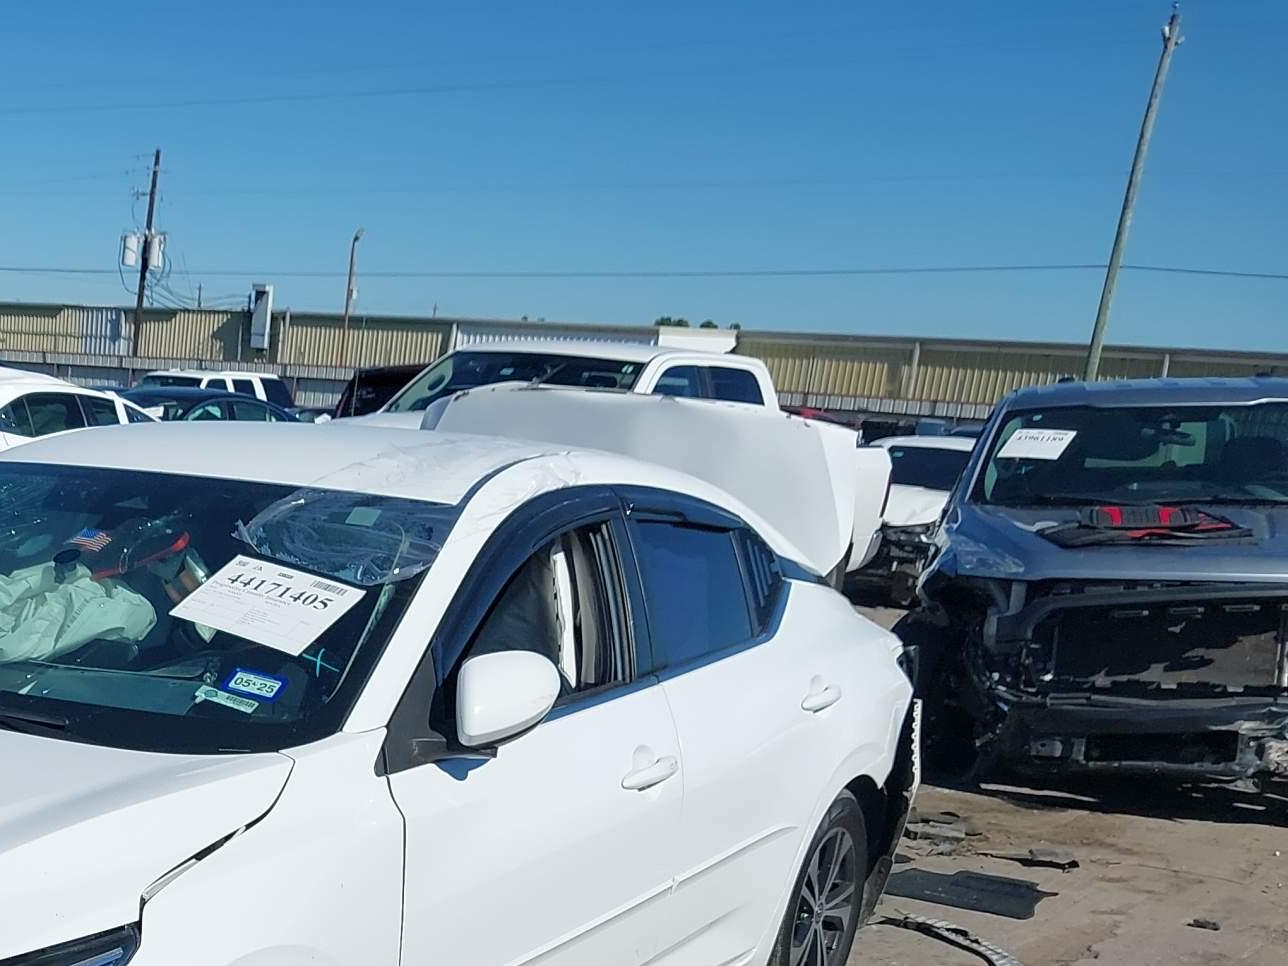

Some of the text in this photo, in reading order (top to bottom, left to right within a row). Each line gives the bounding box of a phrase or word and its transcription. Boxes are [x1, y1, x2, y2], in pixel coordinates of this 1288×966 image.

[227, 573, 335, 611] 44171405
[233, 676, 277, 694] 05 25
